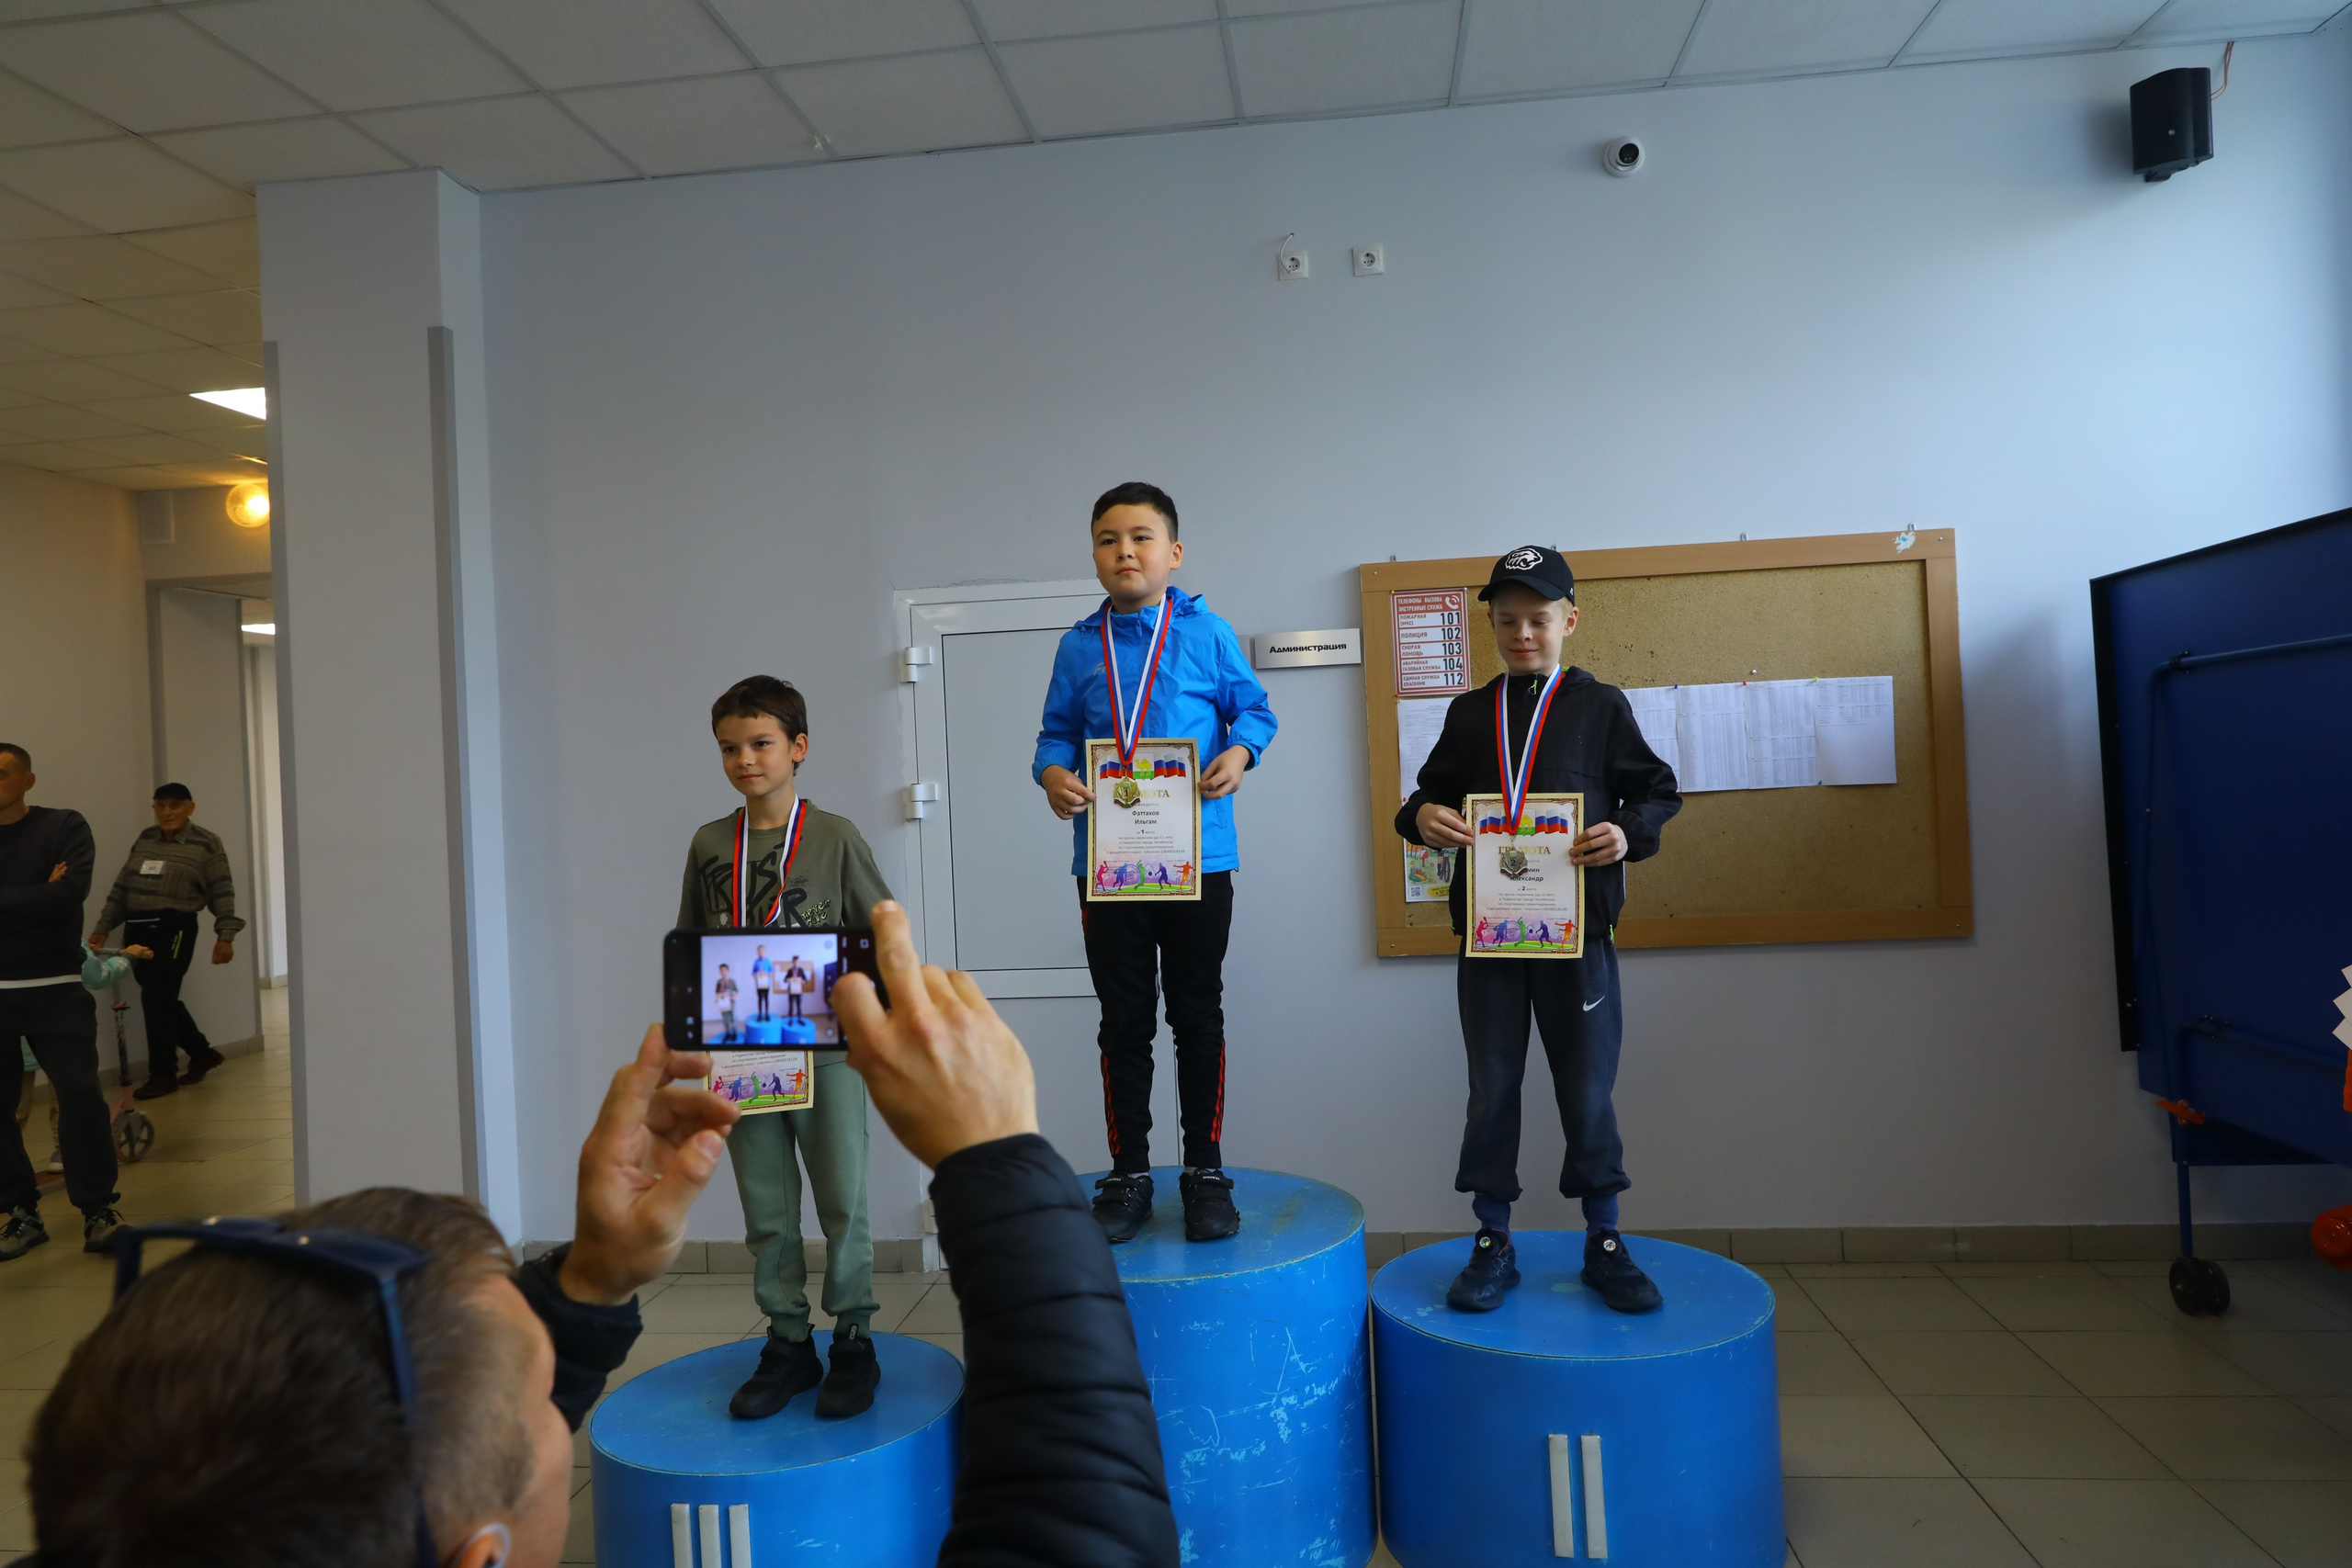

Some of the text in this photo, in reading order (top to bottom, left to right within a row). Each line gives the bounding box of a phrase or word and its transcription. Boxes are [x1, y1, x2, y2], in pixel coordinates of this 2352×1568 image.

[1441, 612, 1460, 625] 101
[1442, 627, 1461, 639] 102
[1269, 644, 1347, 653] Администрация
[1442, 642, 1462, 655] 103
[1443, 658, 1463, 671] 104
[1444, 673, 1464, 685] 112
[1498, 846, 1551, 854] ГРМОТА
